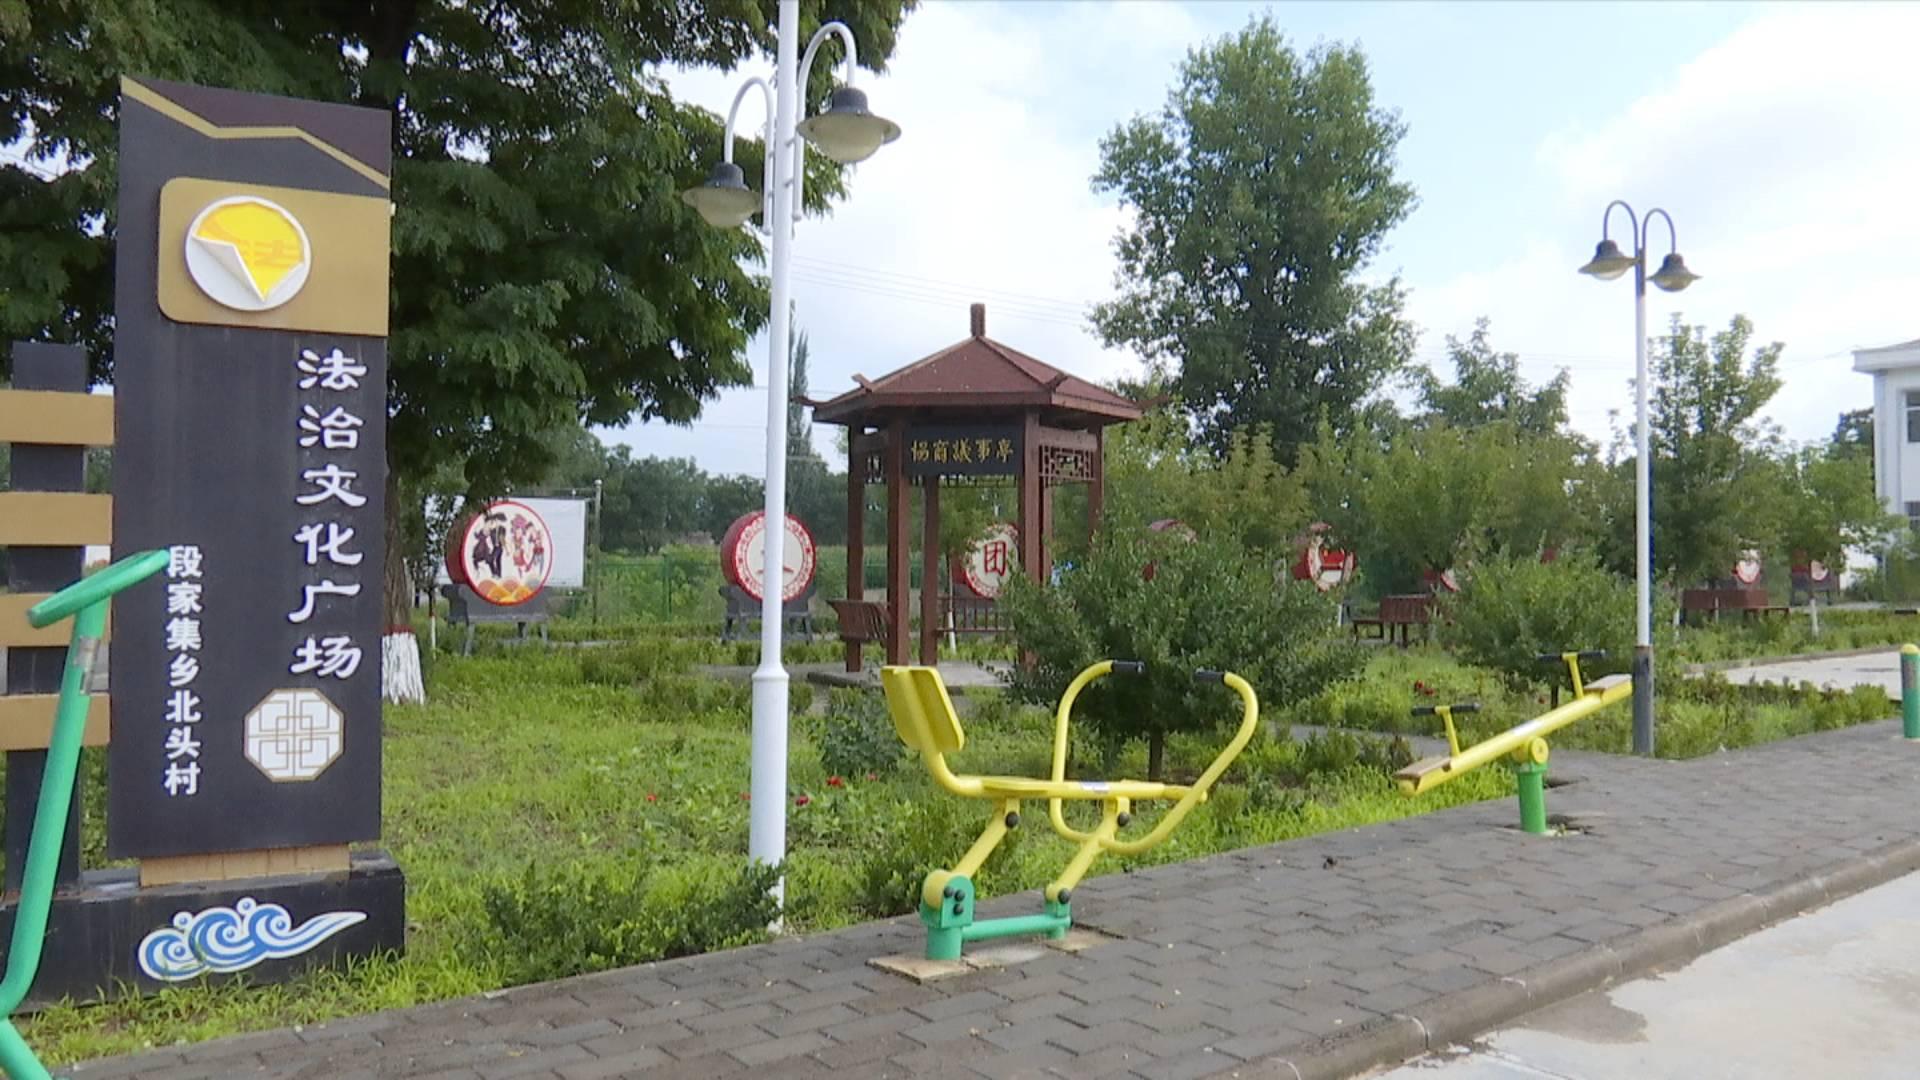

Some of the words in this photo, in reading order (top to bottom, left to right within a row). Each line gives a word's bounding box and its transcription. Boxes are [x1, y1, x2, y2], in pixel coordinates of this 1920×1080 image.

[288, 348, 368, 679] 法治文化广场
[983, 540, 1007, 577] 团
[164, 544, 203, 796] 段家集乡北头村
